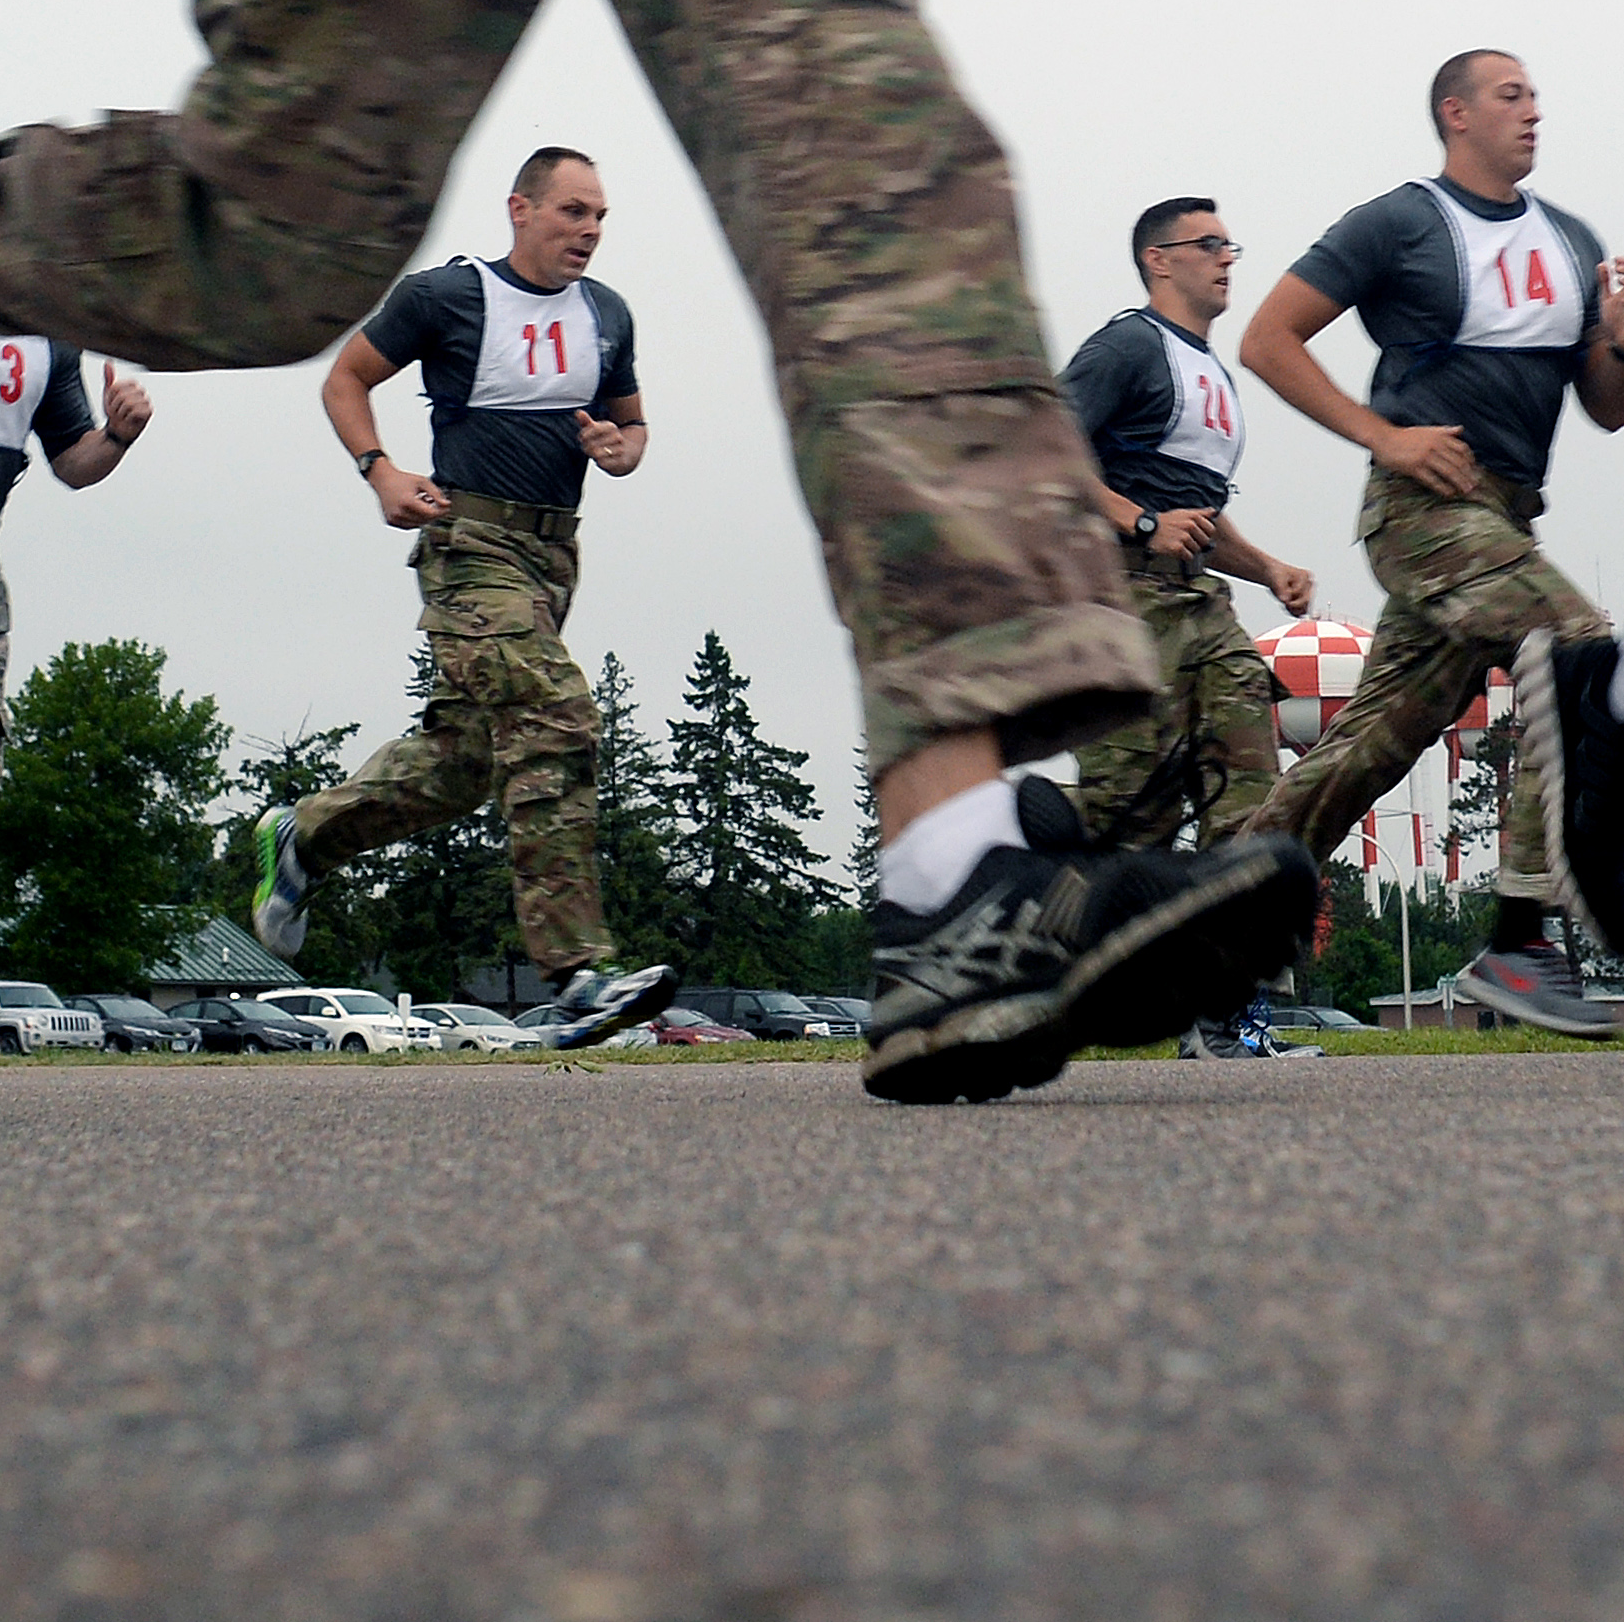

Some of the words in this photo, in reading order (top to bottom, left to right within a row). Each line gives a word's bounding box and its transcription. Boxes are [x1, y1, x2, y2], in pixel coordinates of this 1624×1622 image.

[1494, 247, 1556, 308] 14
[522, 321, 568, 376] 11
[1197, 374, 1232, 438] 24
